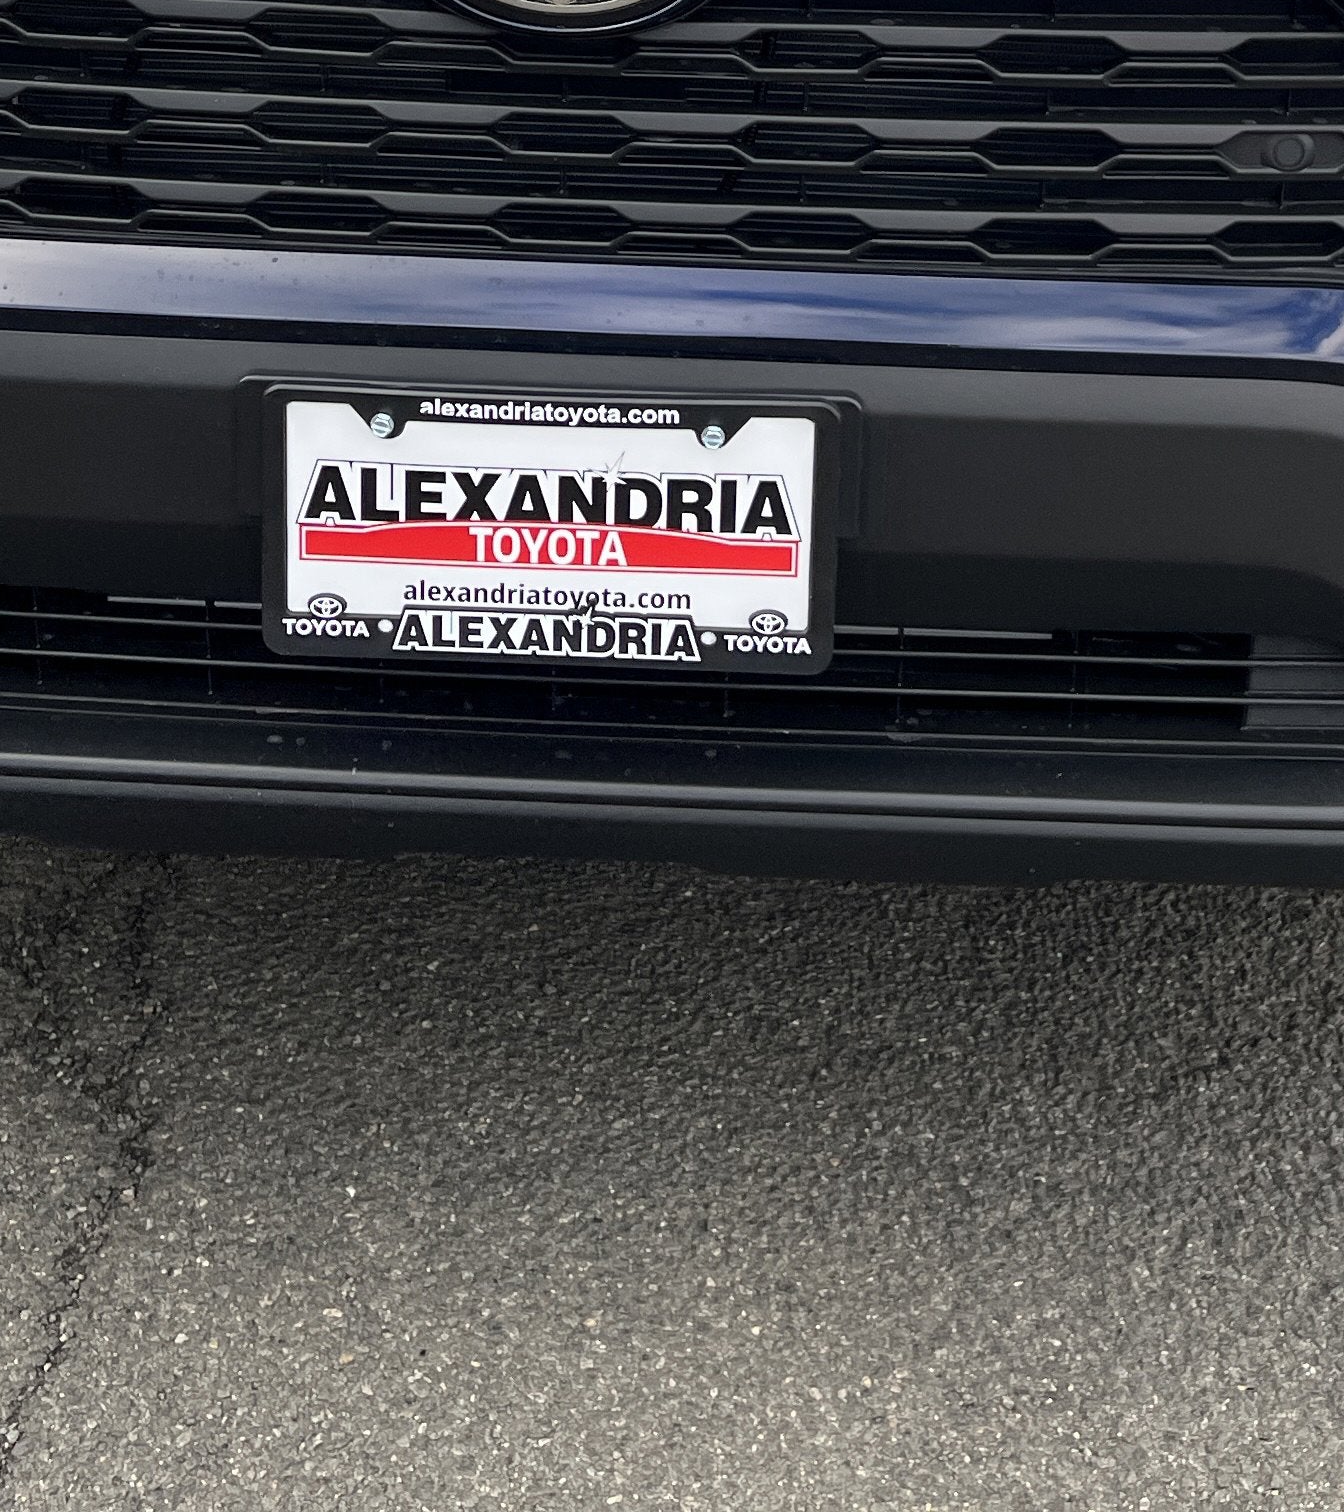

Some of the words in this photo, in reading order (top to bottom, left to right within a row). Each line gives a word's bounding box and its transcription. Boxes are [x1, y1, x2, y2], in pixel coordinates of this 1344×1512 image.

[419, 398, 681, 426] alexandriatoyota.com
[303, 464, 793, 536] ALEXANDRIA
[469, 527, 629, 567] TOYOTA
[403, 579, 692, 610] alexandriatoyota.com
[281, 618, 370, 638] TOYOTA
[395, 610, 698, 660] ALEXANDRIA
[724, 634, 811, 655] TOYOTA
